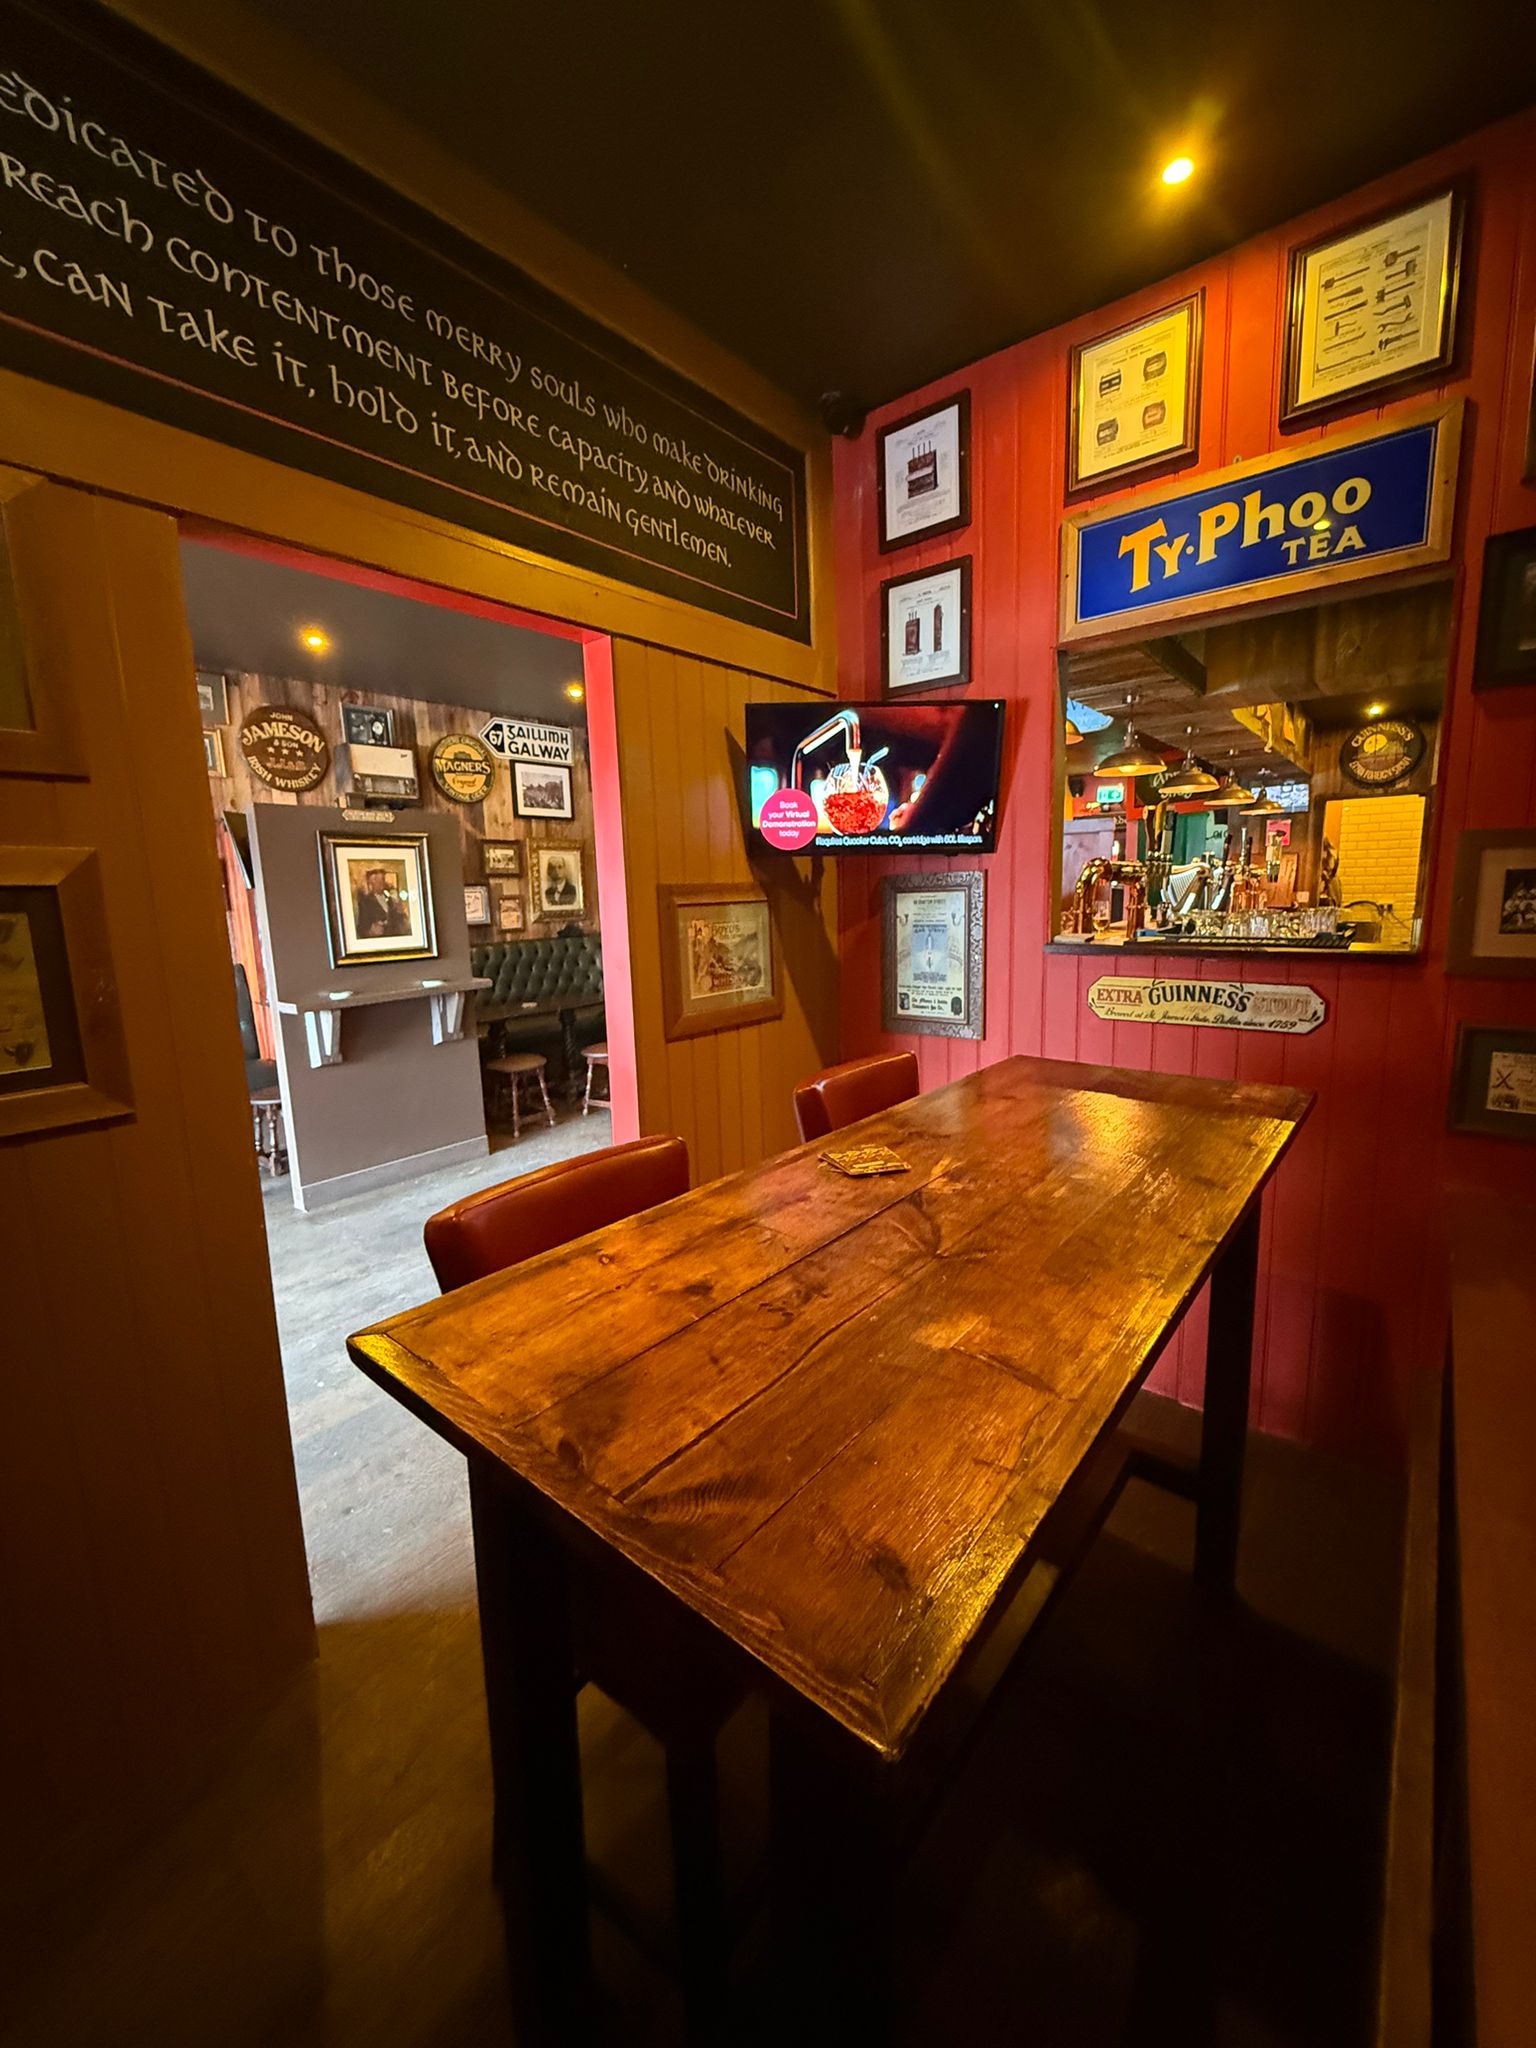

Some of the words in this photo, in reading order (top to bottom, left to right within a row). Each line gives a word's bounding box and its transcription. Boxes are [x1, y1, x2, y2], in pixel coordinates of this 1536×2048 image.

[1280, 523, 1367, 566] TEA
[241, 721, 325, 753] JAMESON
[488, 730, 503, 746] 67
[508, 741, 570, 760] GALWAY
[434, 758, 491, 775] MAGNERS
[1096, 988, 1143, 1004] EXTRA
[1146, 983, 1252, 1012] GUINNESS
[1268, 1019, 1298, 1030] 1759
